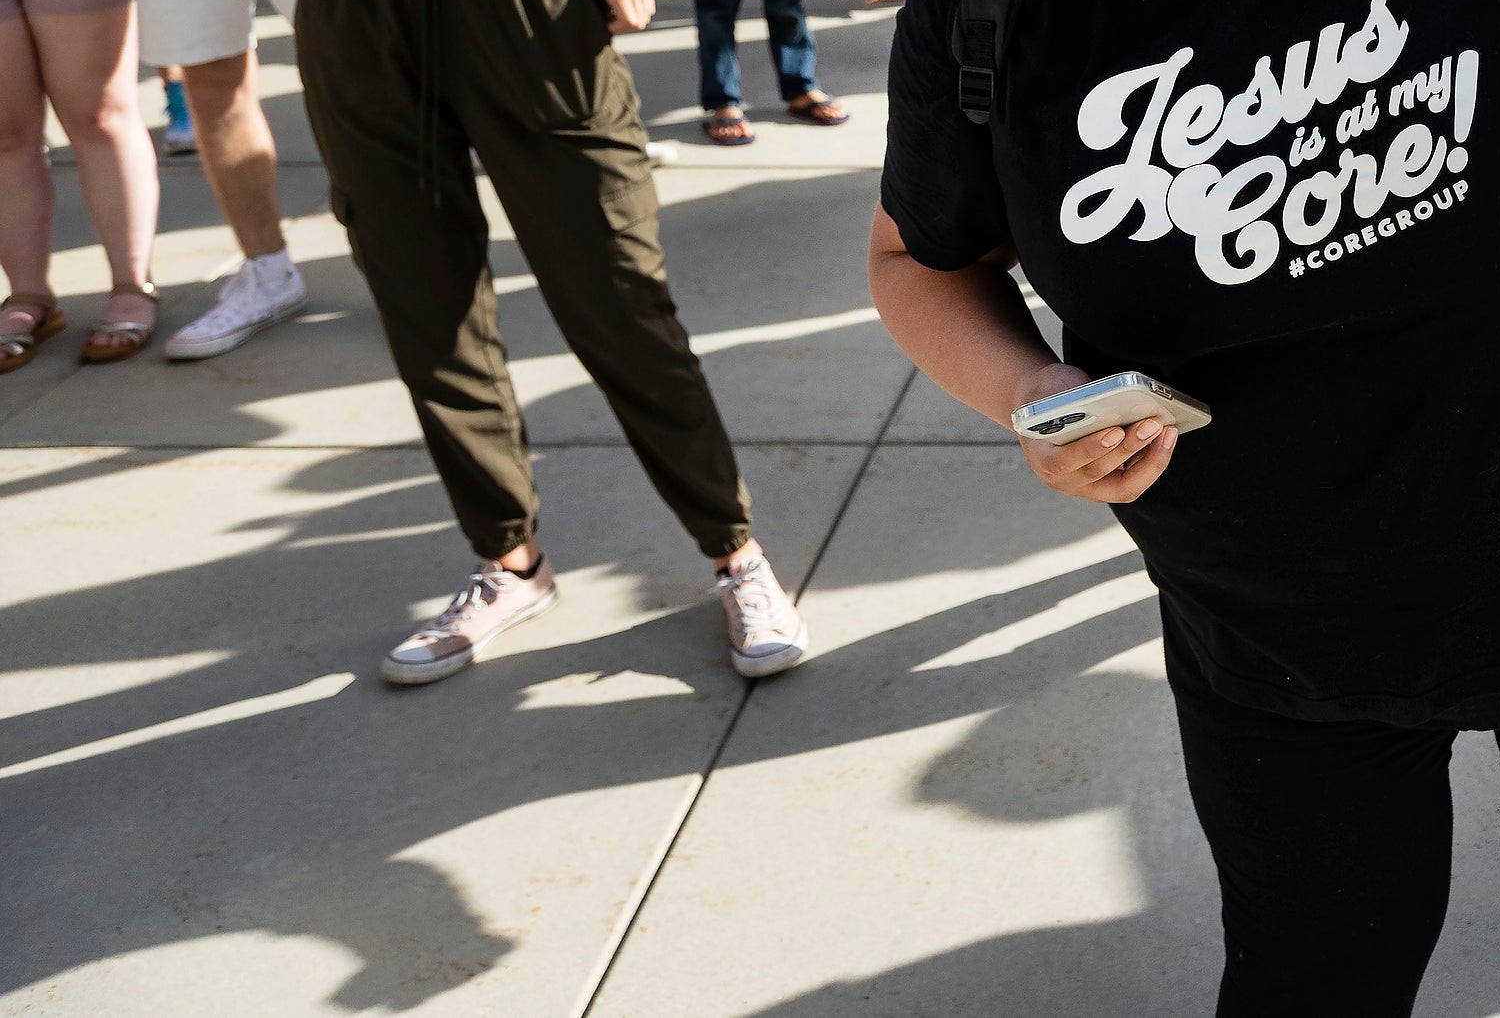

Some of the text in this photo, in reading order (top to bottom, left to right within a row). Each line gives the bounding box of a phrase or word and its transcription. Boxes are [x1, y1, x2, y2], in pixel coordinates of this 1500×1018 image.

[1167, 49, 1480, 285] Core!
[1289, 55, 1453, 167] is at my
[1289, 179, 1470, 279] #COREGROUP
